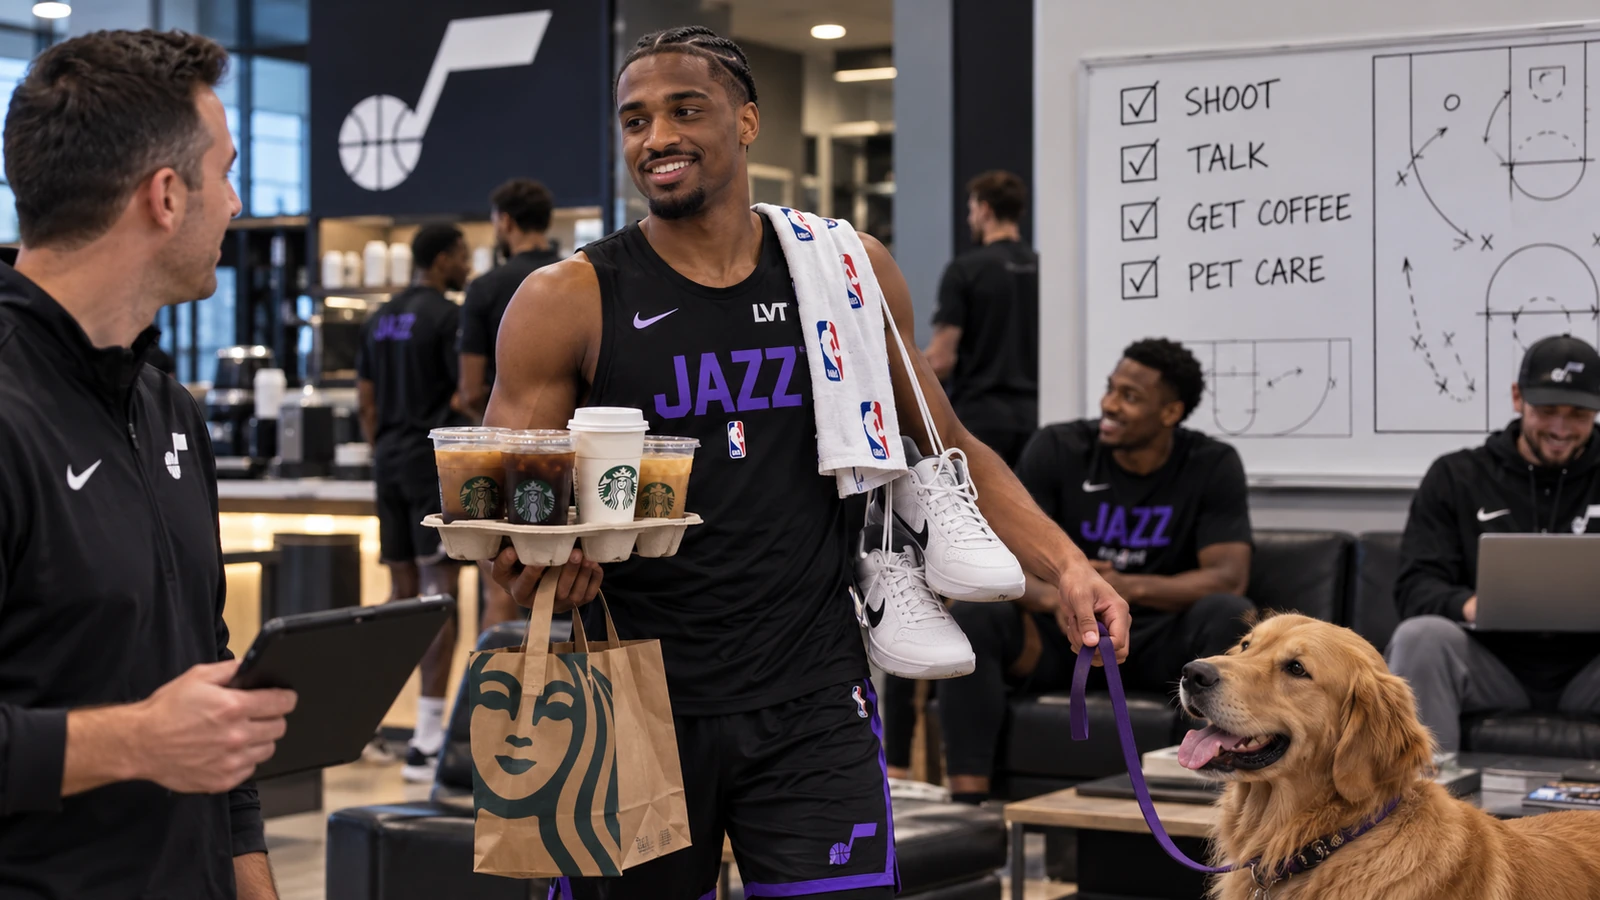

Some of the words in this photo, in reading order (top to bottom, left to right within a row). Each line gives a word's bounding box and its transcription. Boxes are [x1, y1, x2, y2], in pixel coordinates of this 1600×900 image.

[1185, 78, 1281, 116] SHOOT
[1187, 141, 1269, 174] TALK
[1187, 199, 1246, 233] GET
[1257, 193, 1352, 226] COFFEE
[1188, 258, 1243, 292] PET
[1255, 255, 1326, 286] CARE
[752, 302, 788, 323] LVT
[653, 345, 803, 419] JAZZ
[1081, 501, 1174, 549] JAZZ
